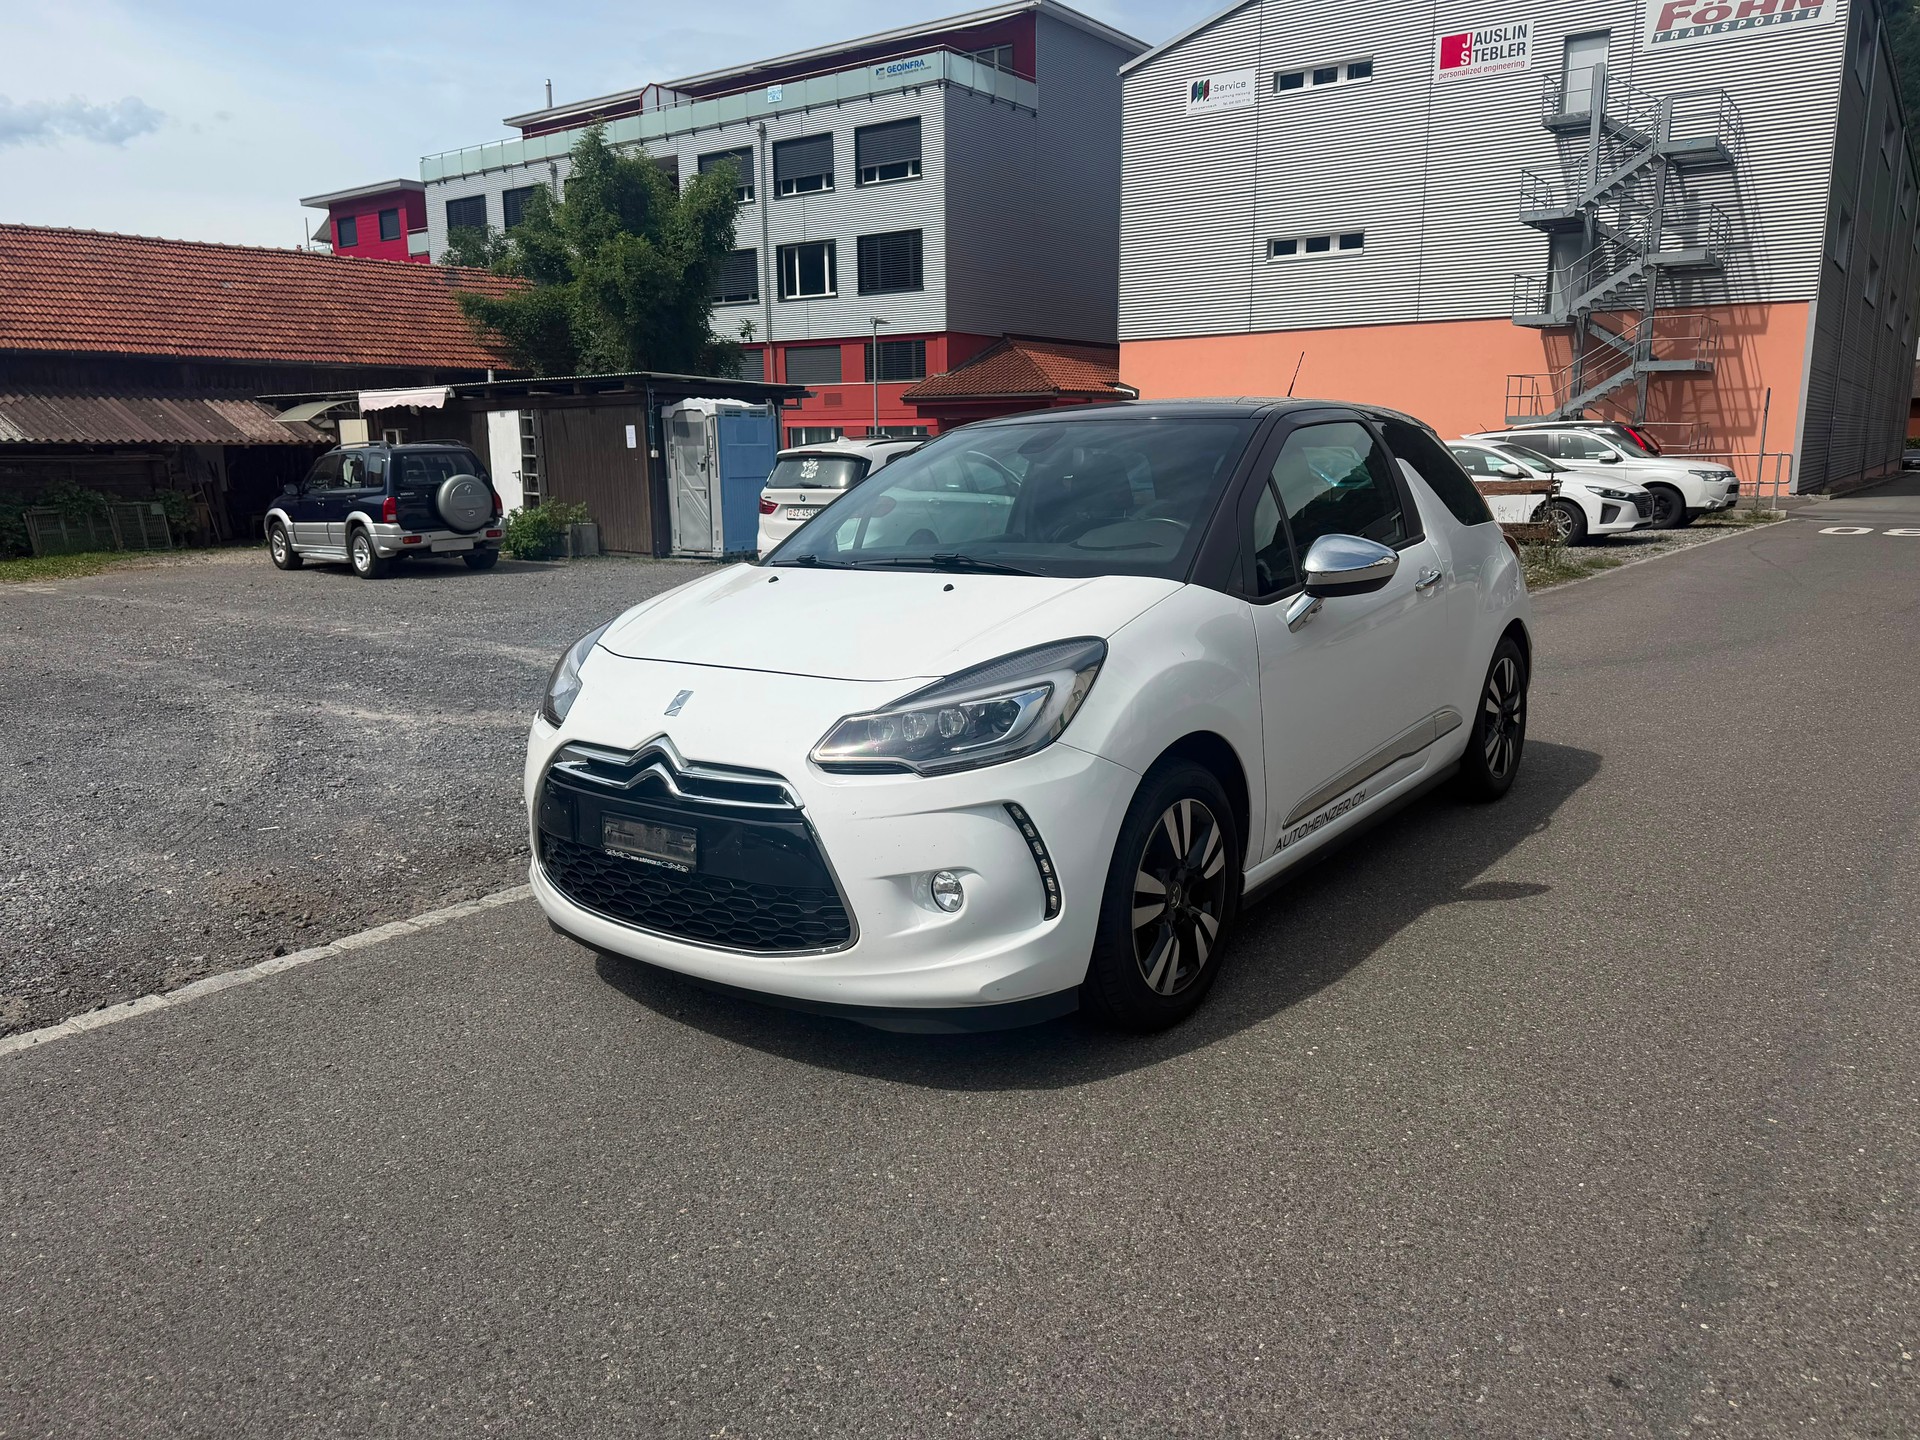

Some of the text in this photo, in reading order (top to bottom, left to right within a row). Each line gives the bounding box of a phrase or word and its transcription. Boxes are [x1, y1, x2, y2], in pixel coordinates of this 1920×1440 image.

[1462, 24, 1528, 49] JAUSLIN
[1655, 8, 1819, 42] TRANSPORTE
[1460, 42, 1526, 66] STEBLER
[886, 59, 925, 74] GEOINFRA
[1439, 60, 1526, 81] personalized engineering
[1272, 788, 1367, 855] AUTOHEINZER.CH
